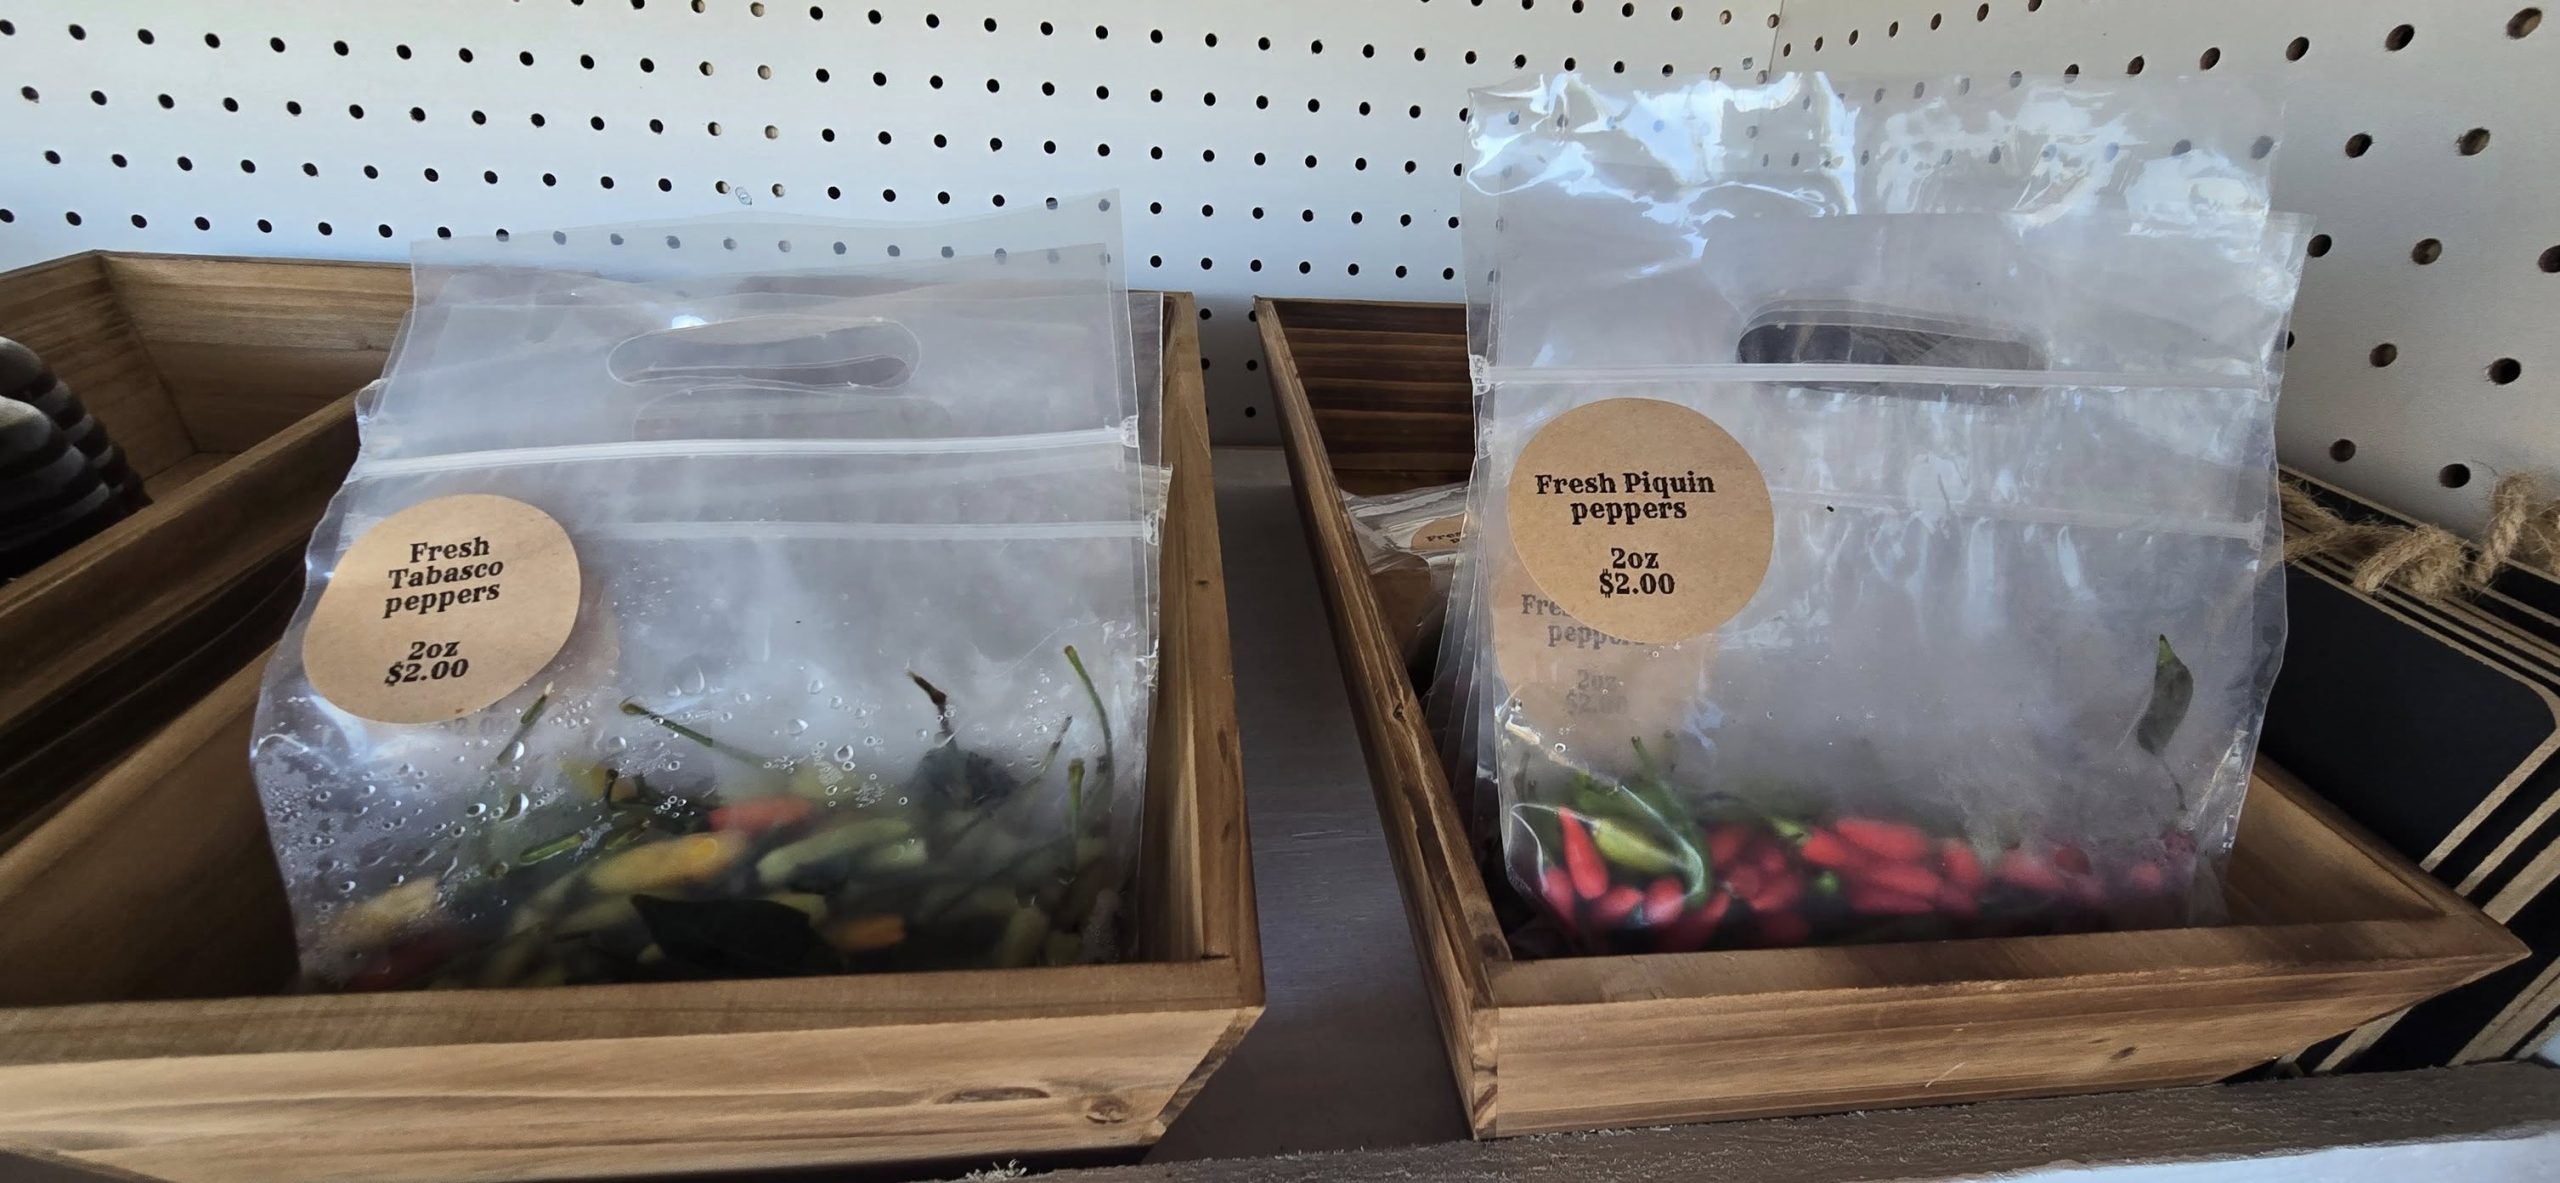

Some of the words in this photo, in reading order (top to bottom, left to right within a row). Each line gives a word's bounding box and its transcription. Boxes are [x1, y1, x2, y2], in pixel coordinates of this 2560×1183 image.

[1535, 473, 1617, 495] Fresh
[1622, 470, 1716, 498] Piquin
[1570, 500, 1687, 525] peppers
[409, 536, 490, 563] Fresh
[1611, 548, 1659, 569] 2oz
[388, 560, 504, 589] Tabasco
[1599, 569, 1675, 598] $2.00
[382, 583, 500, 618] peppers
[408, 640, 460, 661] 2oz
[384, 659, 468, 687] $2.00
